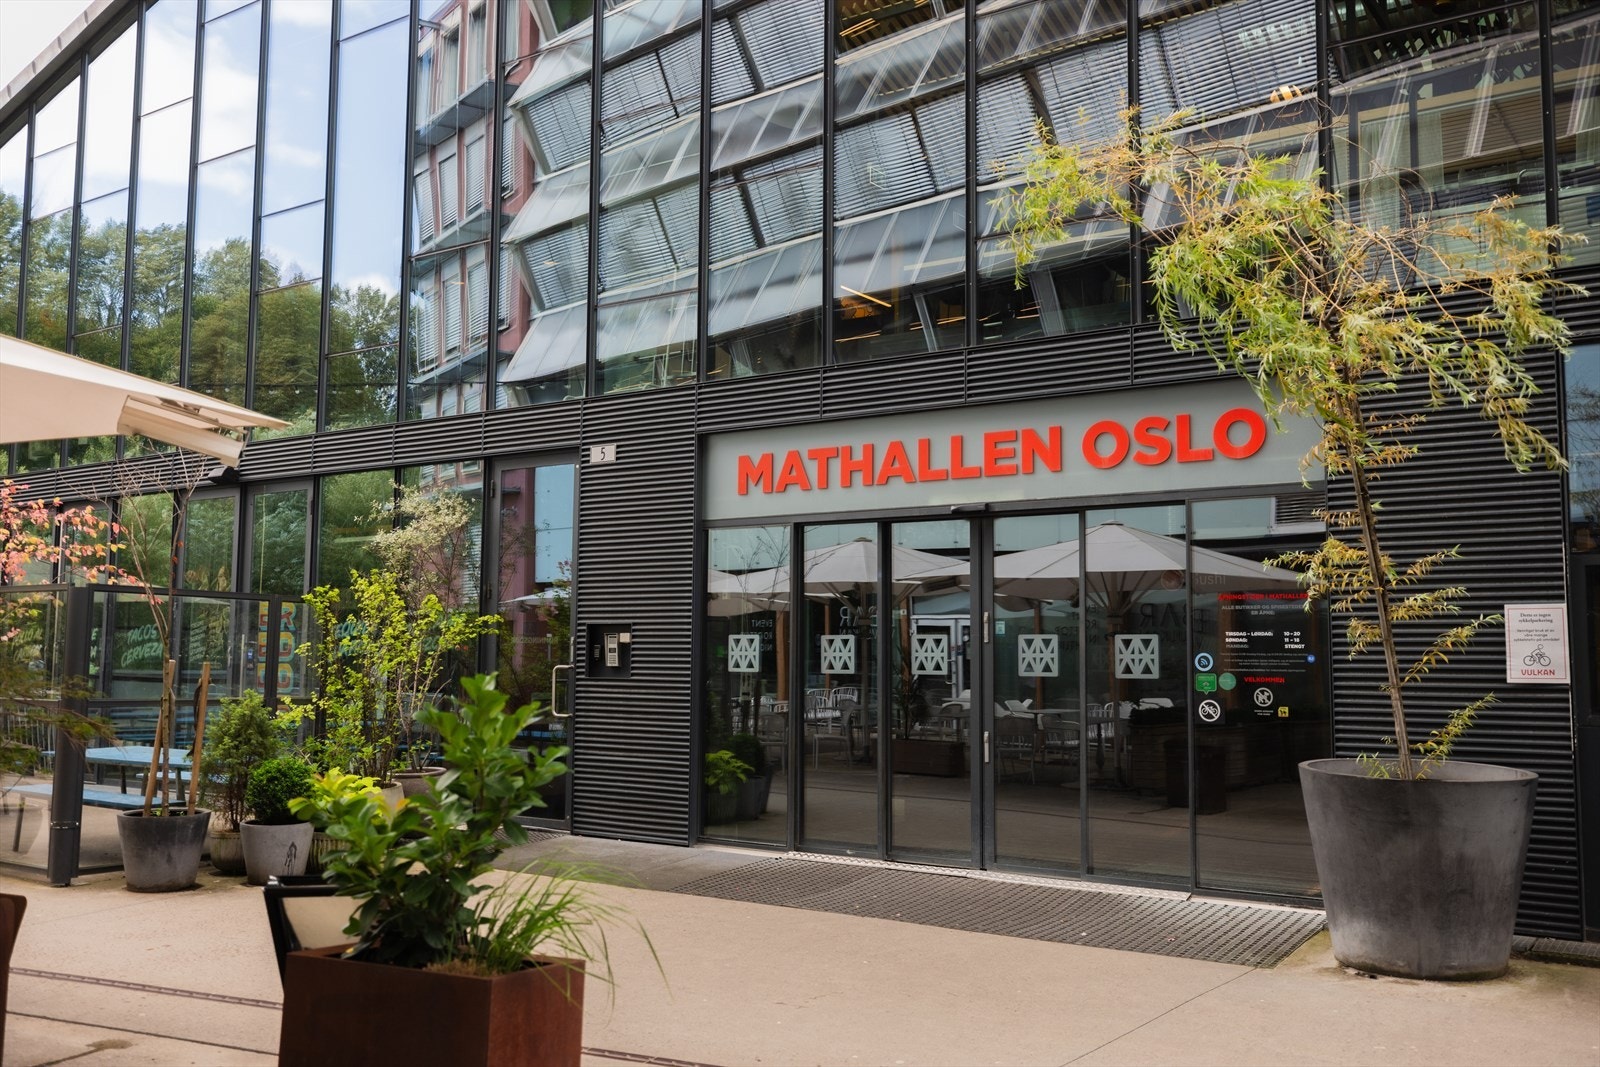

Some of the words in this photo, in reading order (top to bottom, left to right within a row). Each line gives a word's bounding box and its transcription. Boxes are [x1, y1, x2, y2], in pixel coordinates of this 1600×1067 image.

[600, 447, 606, 461] 5
[739, 426, 1061, 495] MATHALLEN
[1082, 408, 1266, 468] OSLO
[127, 624, 159, 645] TACOS
